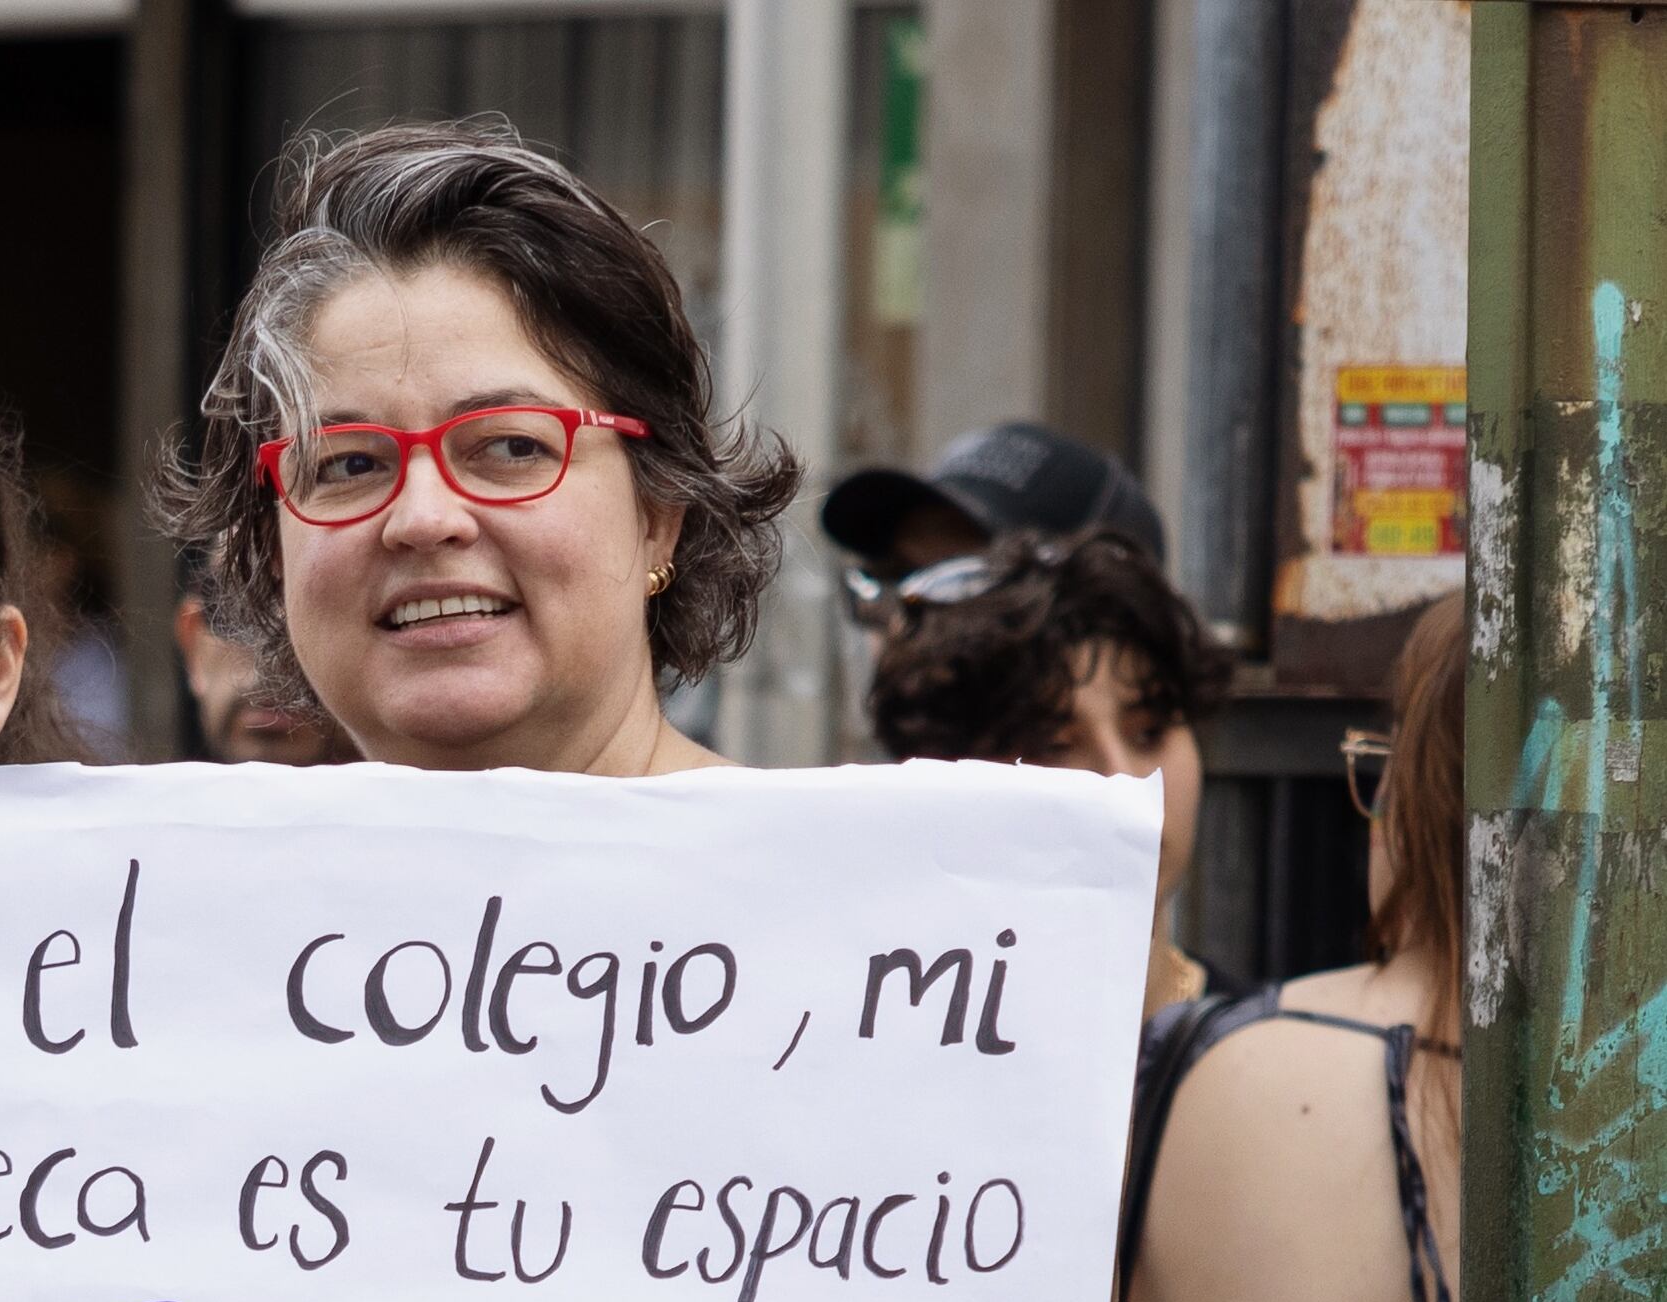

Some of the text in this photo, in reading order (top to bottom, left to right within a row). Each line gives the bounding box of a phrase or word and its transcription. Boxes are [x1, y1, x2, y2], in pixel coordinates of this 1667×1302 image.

[23, 859, 139, 1054] el
[859, 928, 1016, 1054] mi
[240, 1150, 349, 1270] es
[444, 1137, 573, 1284] tu
